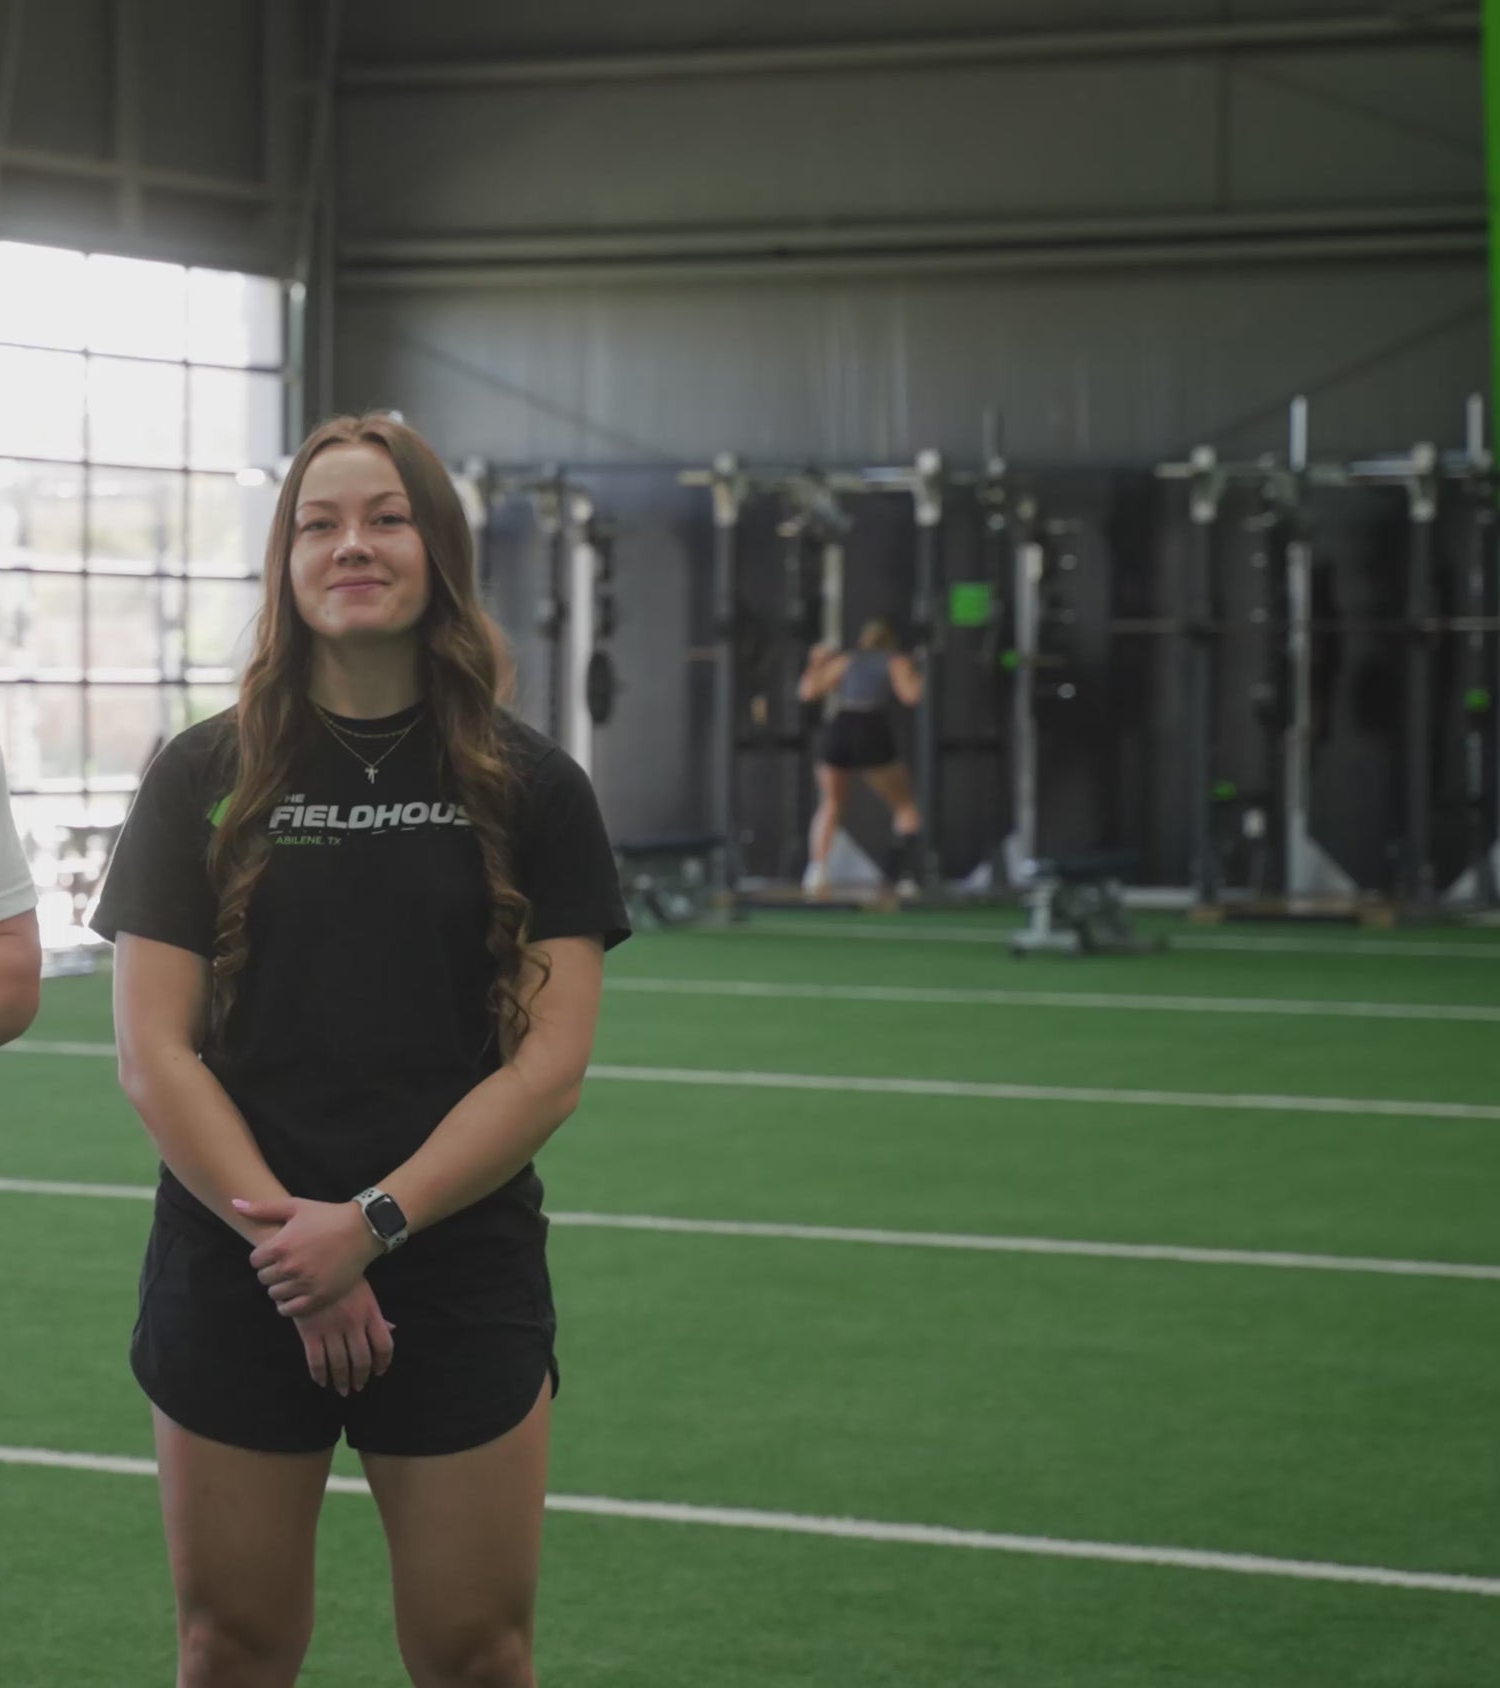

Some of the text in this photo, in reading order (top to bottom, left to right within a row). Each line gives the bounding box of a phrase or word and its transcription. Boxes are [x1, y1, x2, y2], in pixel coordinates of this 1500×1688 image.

[279, 793, 305, 804] HE
[268, 801, 473, 830] FIELDHOUS
[327, 836, 342, 846] TX
